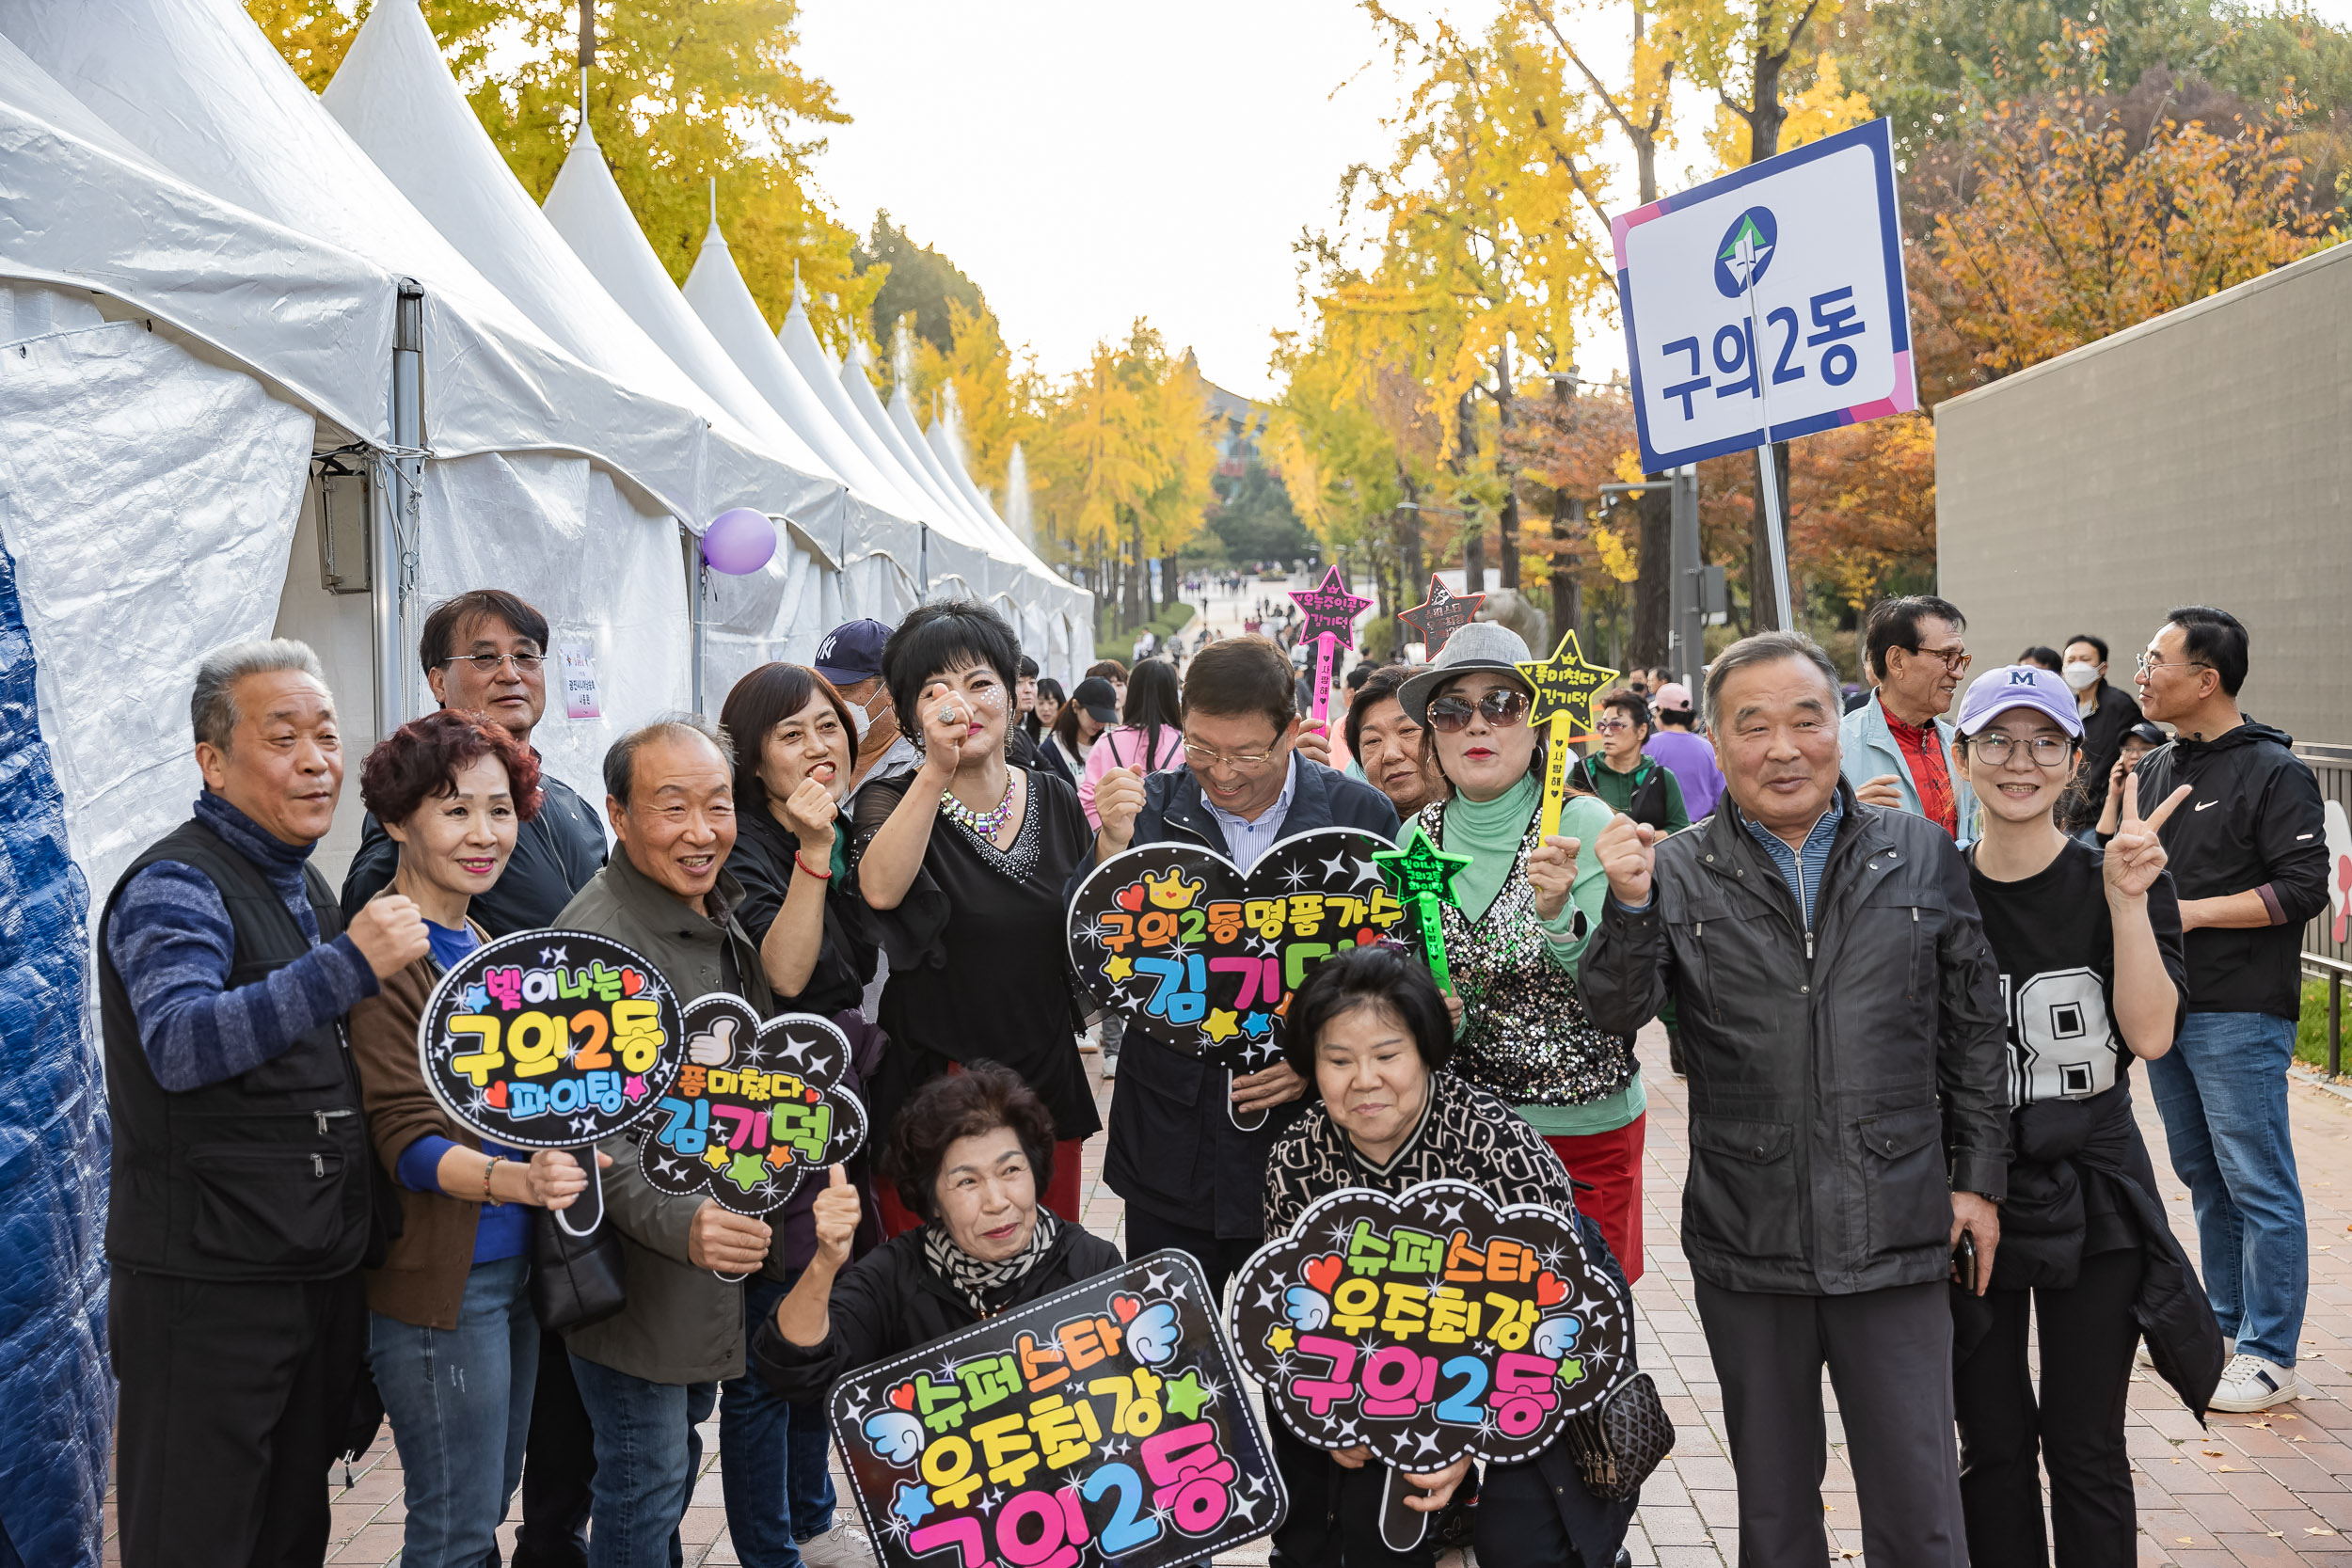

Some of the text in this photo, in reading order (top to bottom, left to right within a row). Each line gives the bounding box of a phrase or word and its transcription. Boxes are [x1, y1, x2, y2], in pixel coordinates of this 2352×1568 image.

[1661, 285, 1866, 420] 구의2동
[1311, 613, 1348, 630] 김기덕
[1319, 665, 1330, 694] 사랑해
[1535, 664, 1597, 686] 폼미쳤다
[1541, 689, 1587, 707] 김기덕
[2009, 671, 2036, 687] M
[1550, 752, 1564, 786] 사랑해
[1406, 870, 1441, 882] 구의2동
[486, 961, 624, 1011] 빛이나는
[449, 999, 665, 1087] 구의2동
[509, 1070, 622, 1117] 파이팅
[678, 1065, 804, 1101] 폼미쳤다
[657, 1096, 830, 1161] 김기덕
[1347, 1221, 1540, 1283] 슈퍼스타
[1332, 1277, 1540, 1351] 우주최강
[915, 1318, 1121, 1433] 슈퍼스타
[1293, 1335, 1557, 1435] 구의2동
[921, 1367, 1162, 1509] 우주최강
